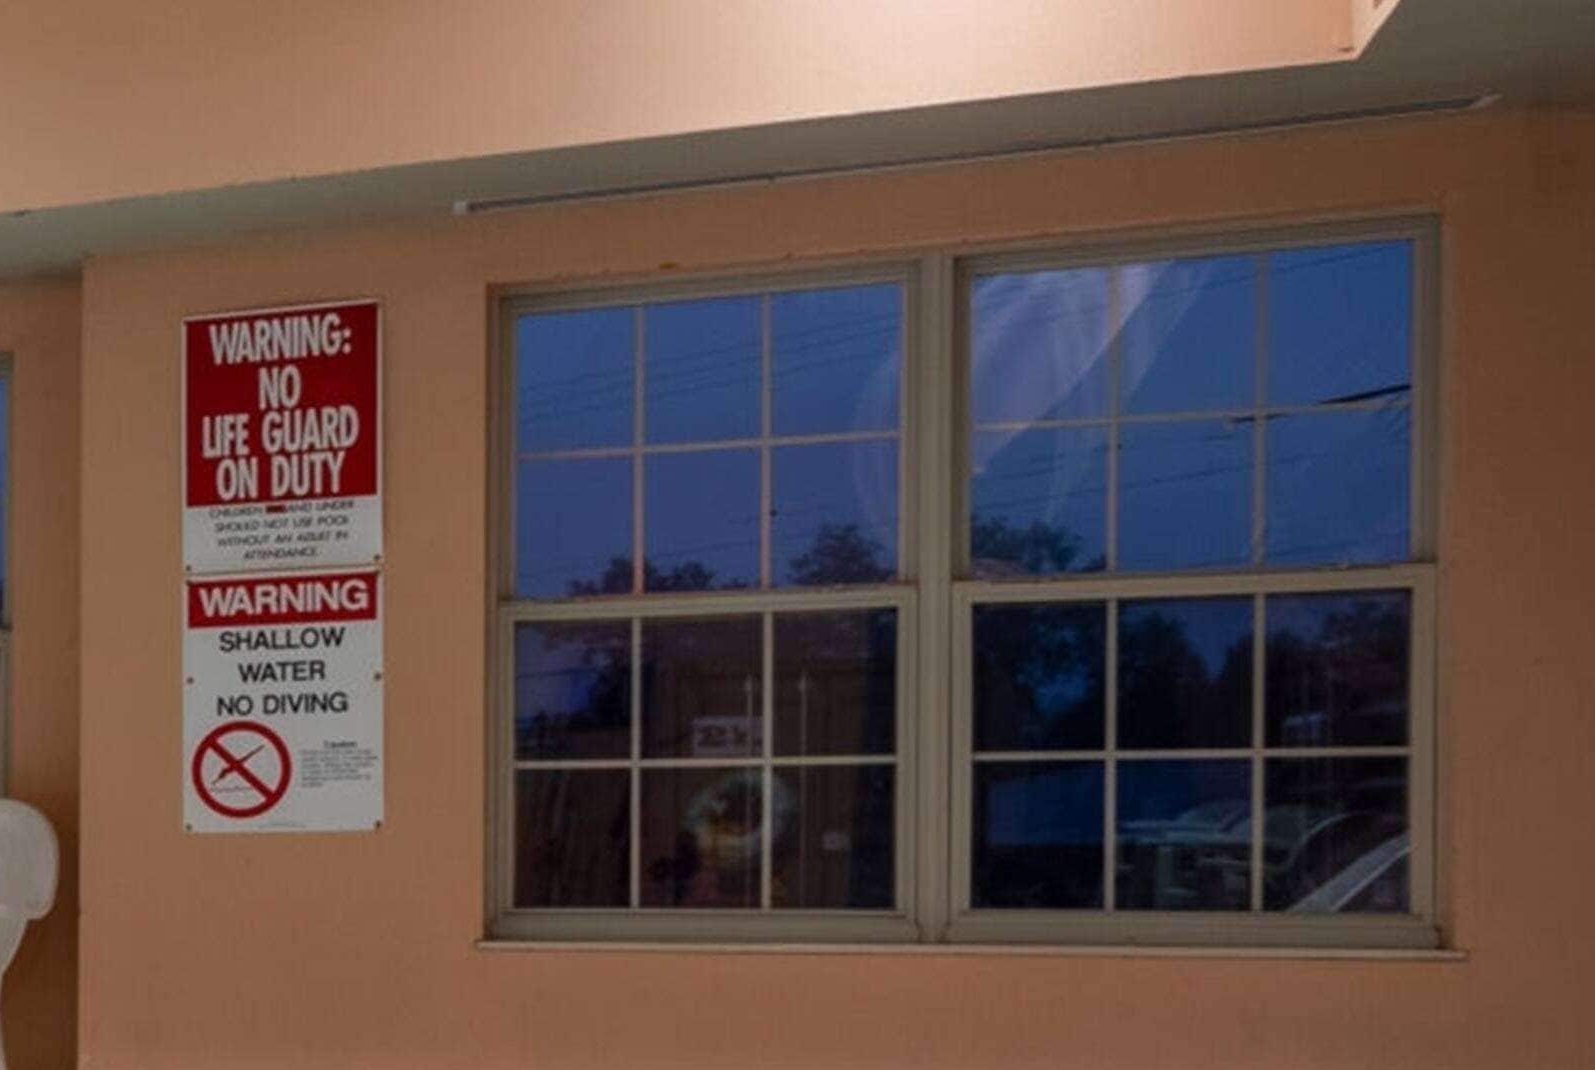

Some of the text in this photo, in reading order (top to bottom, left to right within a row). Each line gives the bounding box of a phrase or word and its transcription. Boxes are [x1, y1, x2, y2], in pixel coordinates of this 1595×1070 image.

[209, 313, 352, 365] WARNING:
[258, 365, 301, 410] NO
[202, 404, 359, 458] LIFE GUARD
[216, 451, 345, 500] ON DUTY
[263, 518, 289, 529] NOT
[293, 516, 313, 527] USE
[199, 579, 369, 618] WARNING
[219, 627, 345, 652] SHALLOW
[238, 660, 326, 683] WATER
[216, 692, 349, 716] NO DIVING
